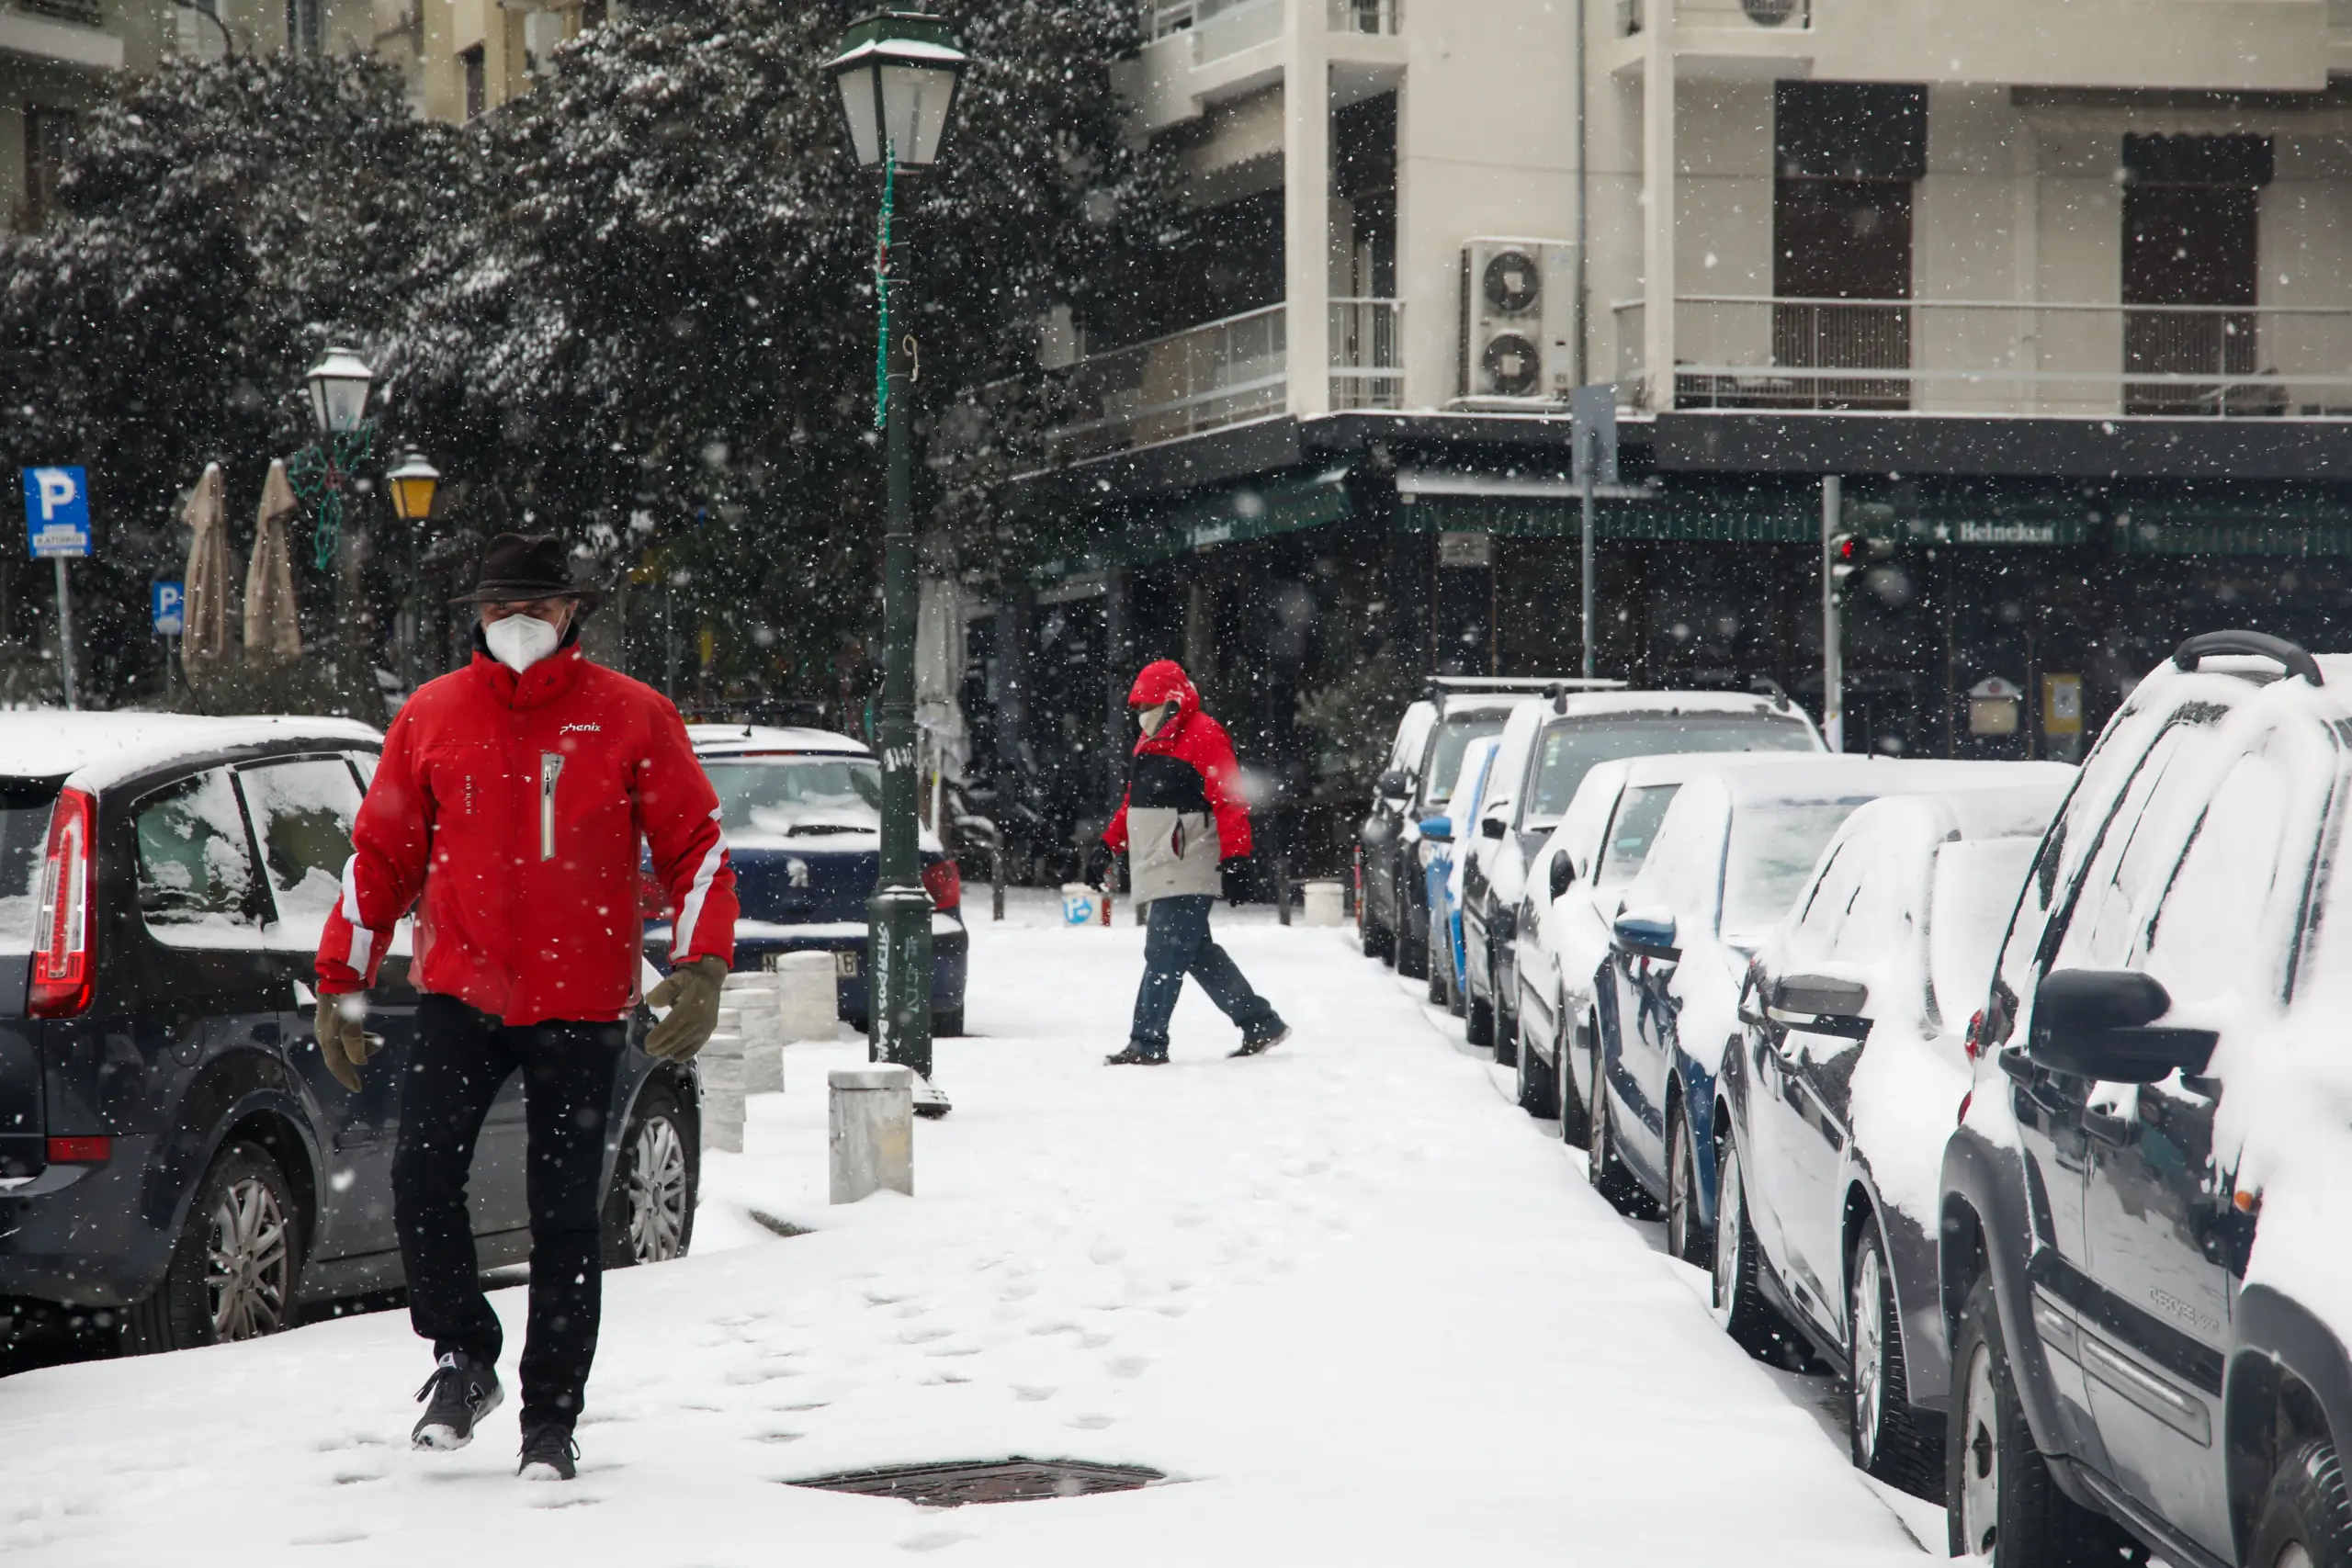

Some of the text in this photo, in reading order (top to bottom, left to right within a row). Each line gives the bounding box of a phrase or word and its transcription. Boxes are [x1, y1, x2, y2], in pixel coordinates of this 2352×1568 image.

[36, 469, 75, 521] P
[1960, 520, 2055, 542] Heineken
[160, 586, 179, 613] P
[560, 722, 601, 735] phenix
